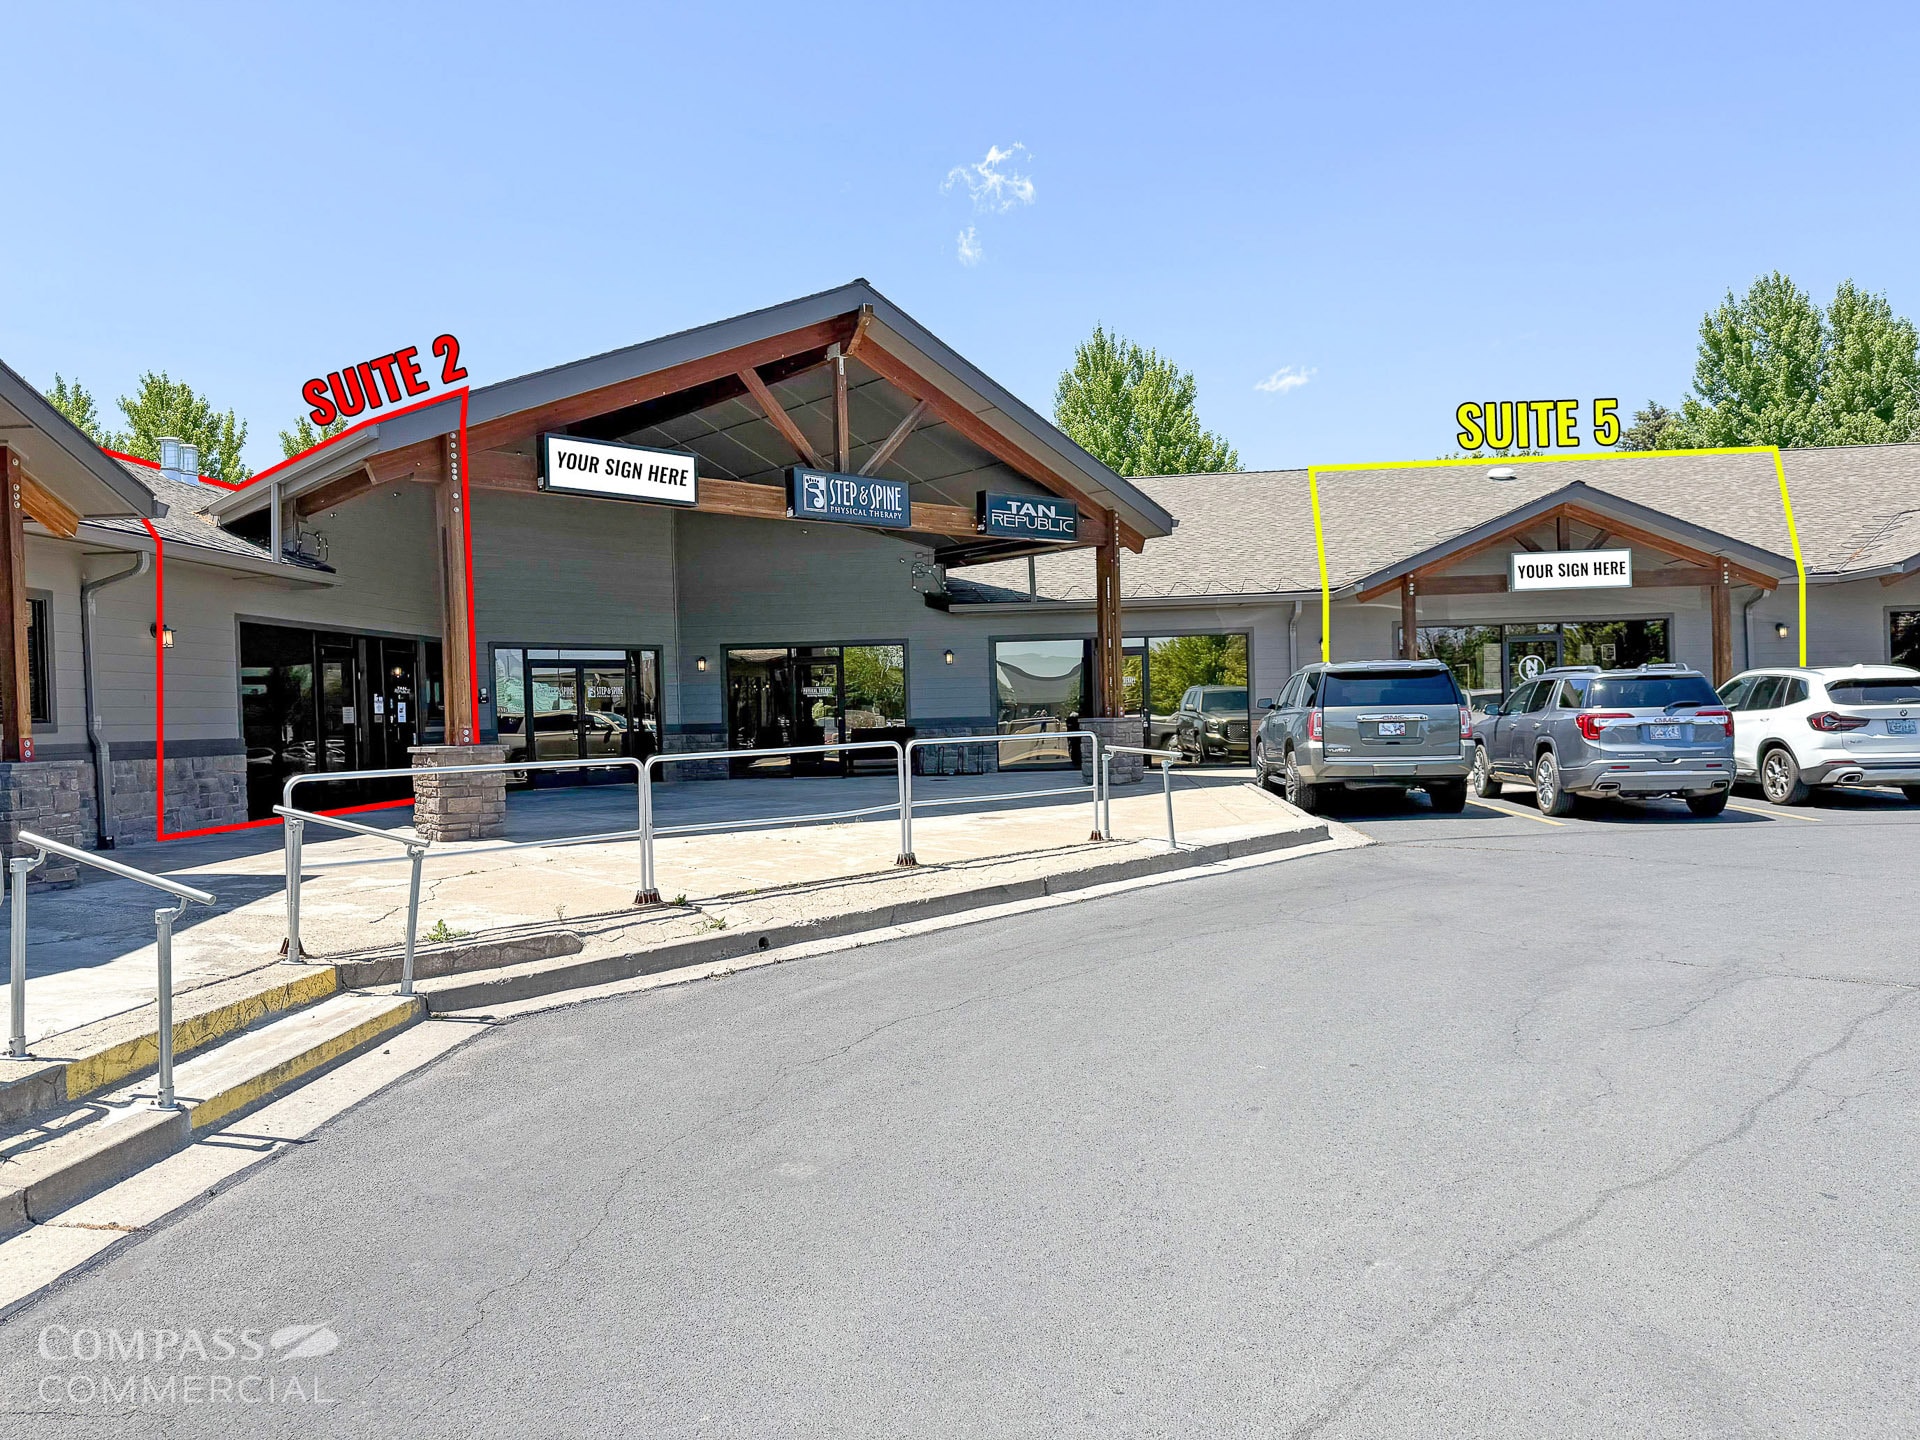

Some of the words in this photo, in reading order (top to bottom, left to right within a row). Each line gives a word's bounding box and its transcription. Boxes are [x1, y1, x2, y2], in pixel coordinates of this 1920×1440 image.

[557, 451, 600, 474] YOUR
[605, 458, 643, 480] SIGN
[648, 464, 689, 487] HERE
[829, 479, 857, 506] STEP
[860, 486, 868, 506] &
[870, 484, 902, 511] SPINE
[830, 506, 867, 517] PHYSICAL
[869, 510, 903, 520] THERAPY
[1006, 501, 1056, 519] TAN
[991, 513, 1074, 533] REPUBLIC
[1517, 564, 1554, 579] YOUR
[1558, 562, 1589, 577] SIGN
[1593, 561, 1627, 576] HERE
